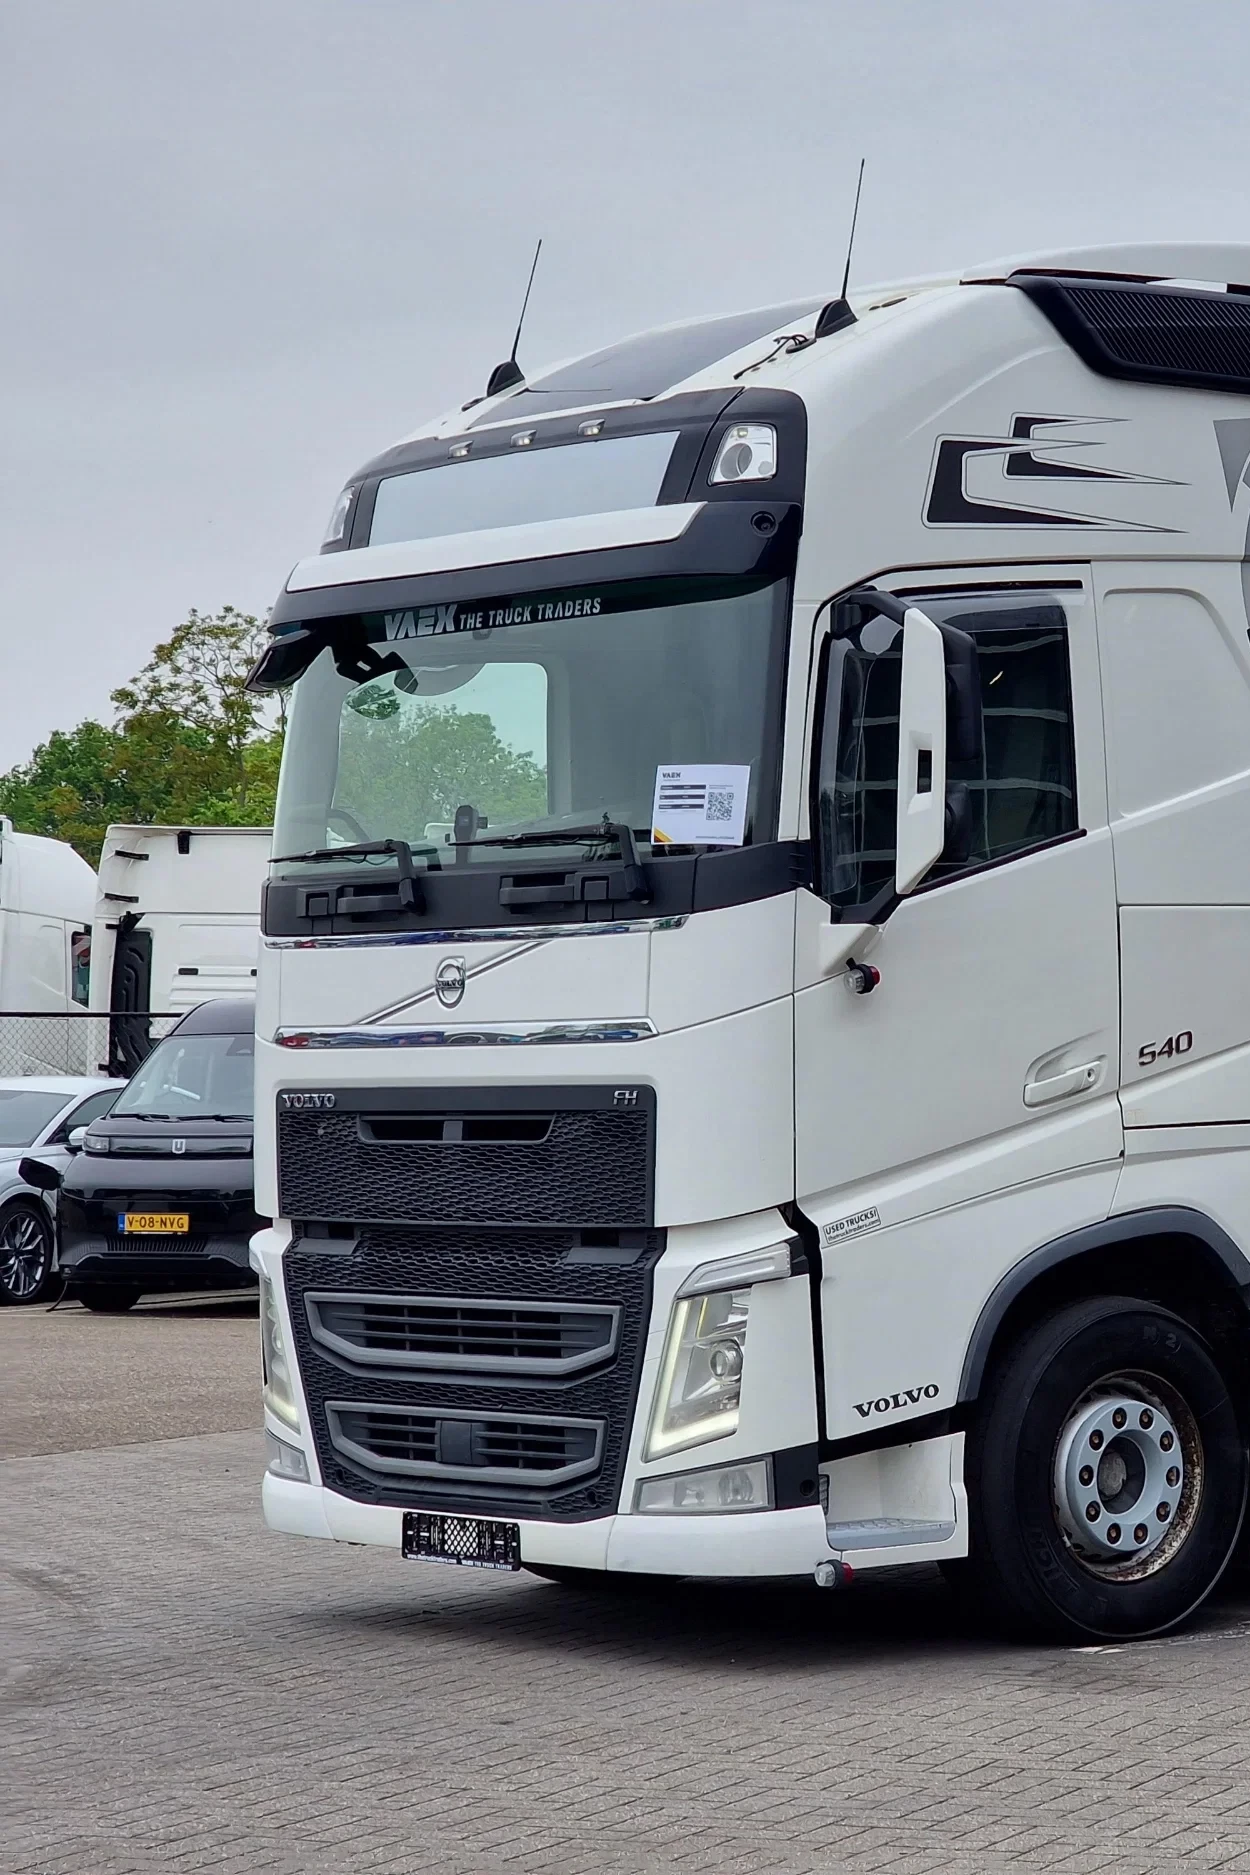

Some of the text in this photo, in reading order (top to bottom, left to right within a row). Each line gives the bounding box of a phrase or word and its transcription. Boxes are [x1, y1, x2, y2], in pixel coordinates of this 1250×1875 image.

[384, 598, 601, 641] VAEX THE TRUCK TRADERS
[1138, 1030, 1193, 1066] 540
[281, 1093, 335, 1108] VOLVO
[613, 1090, 639, 1105] FH
[127, 1216, 185, 1229] V-08-NVG
[825, 1222, 845, 1235] USED
[852, 1383, 940, 1418] VOLVO
